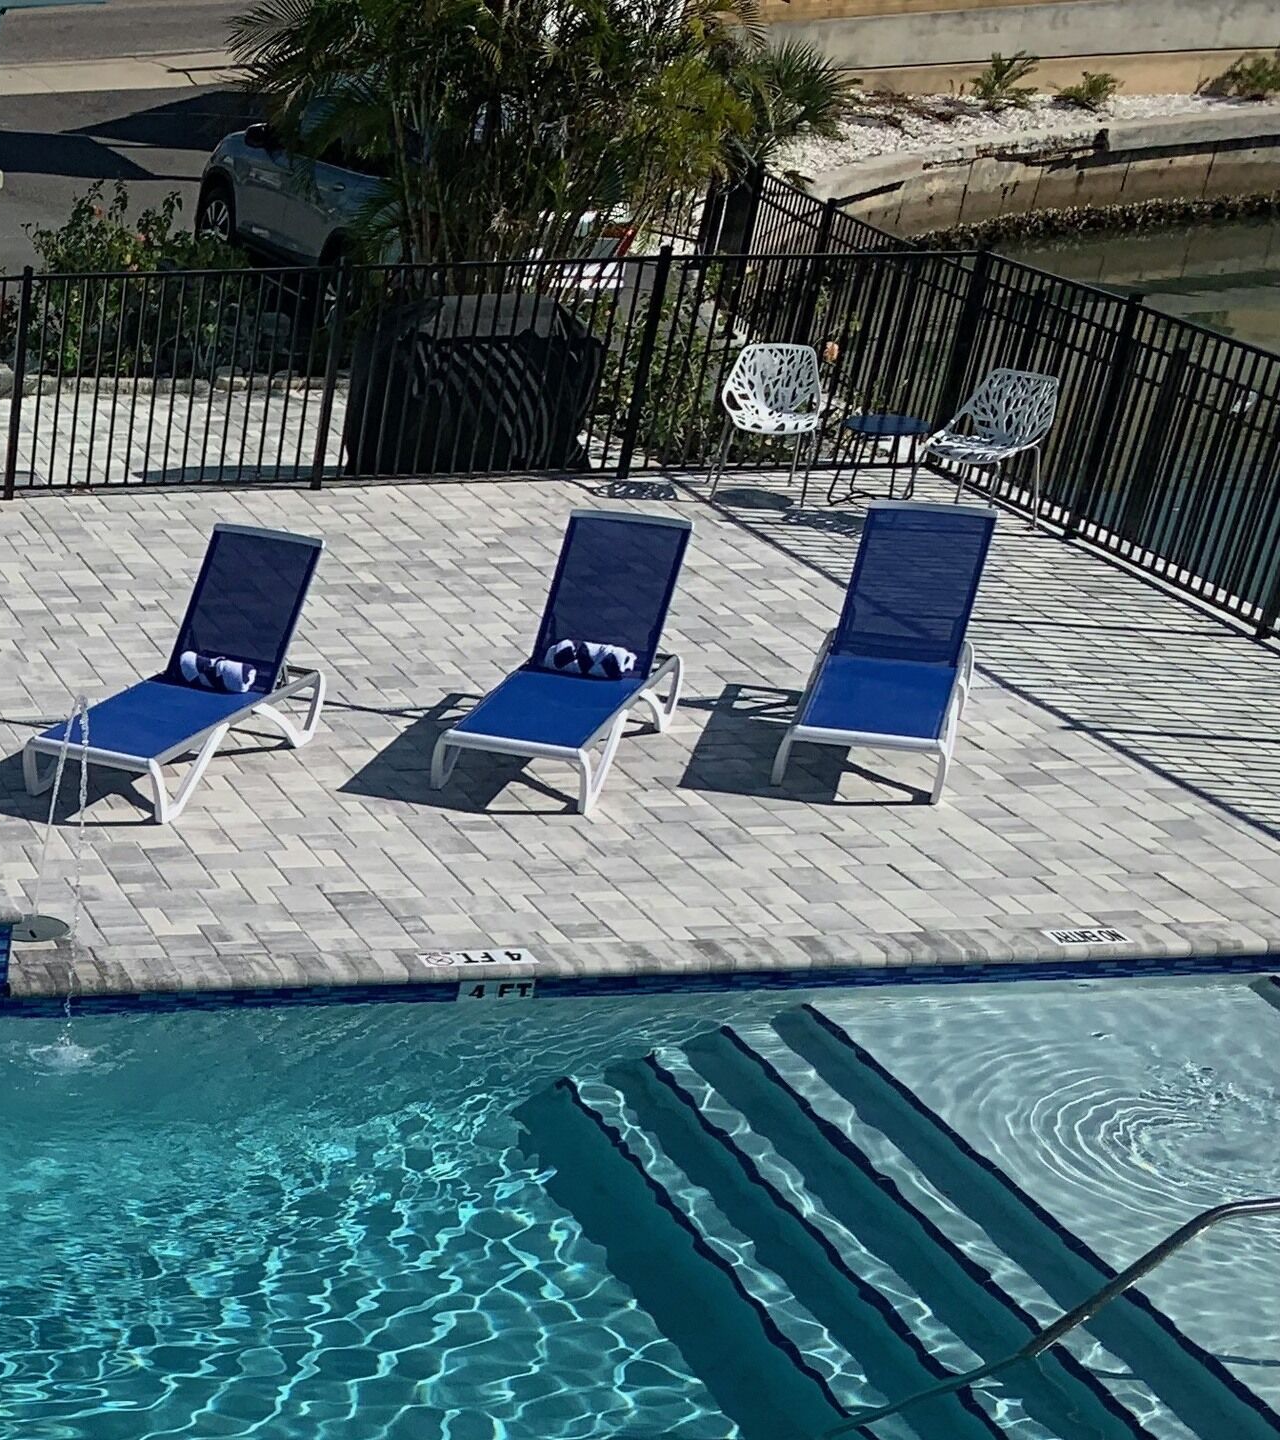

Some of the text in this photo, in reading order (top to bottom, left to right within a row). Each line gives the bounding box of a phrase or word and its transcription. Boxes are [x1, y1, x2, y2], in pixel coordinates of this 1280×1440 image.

[1050, 929, 1128, 943] NO ENTRY
[504, 951, 521, 961] 4
[468, 985, 485, 999] 4
